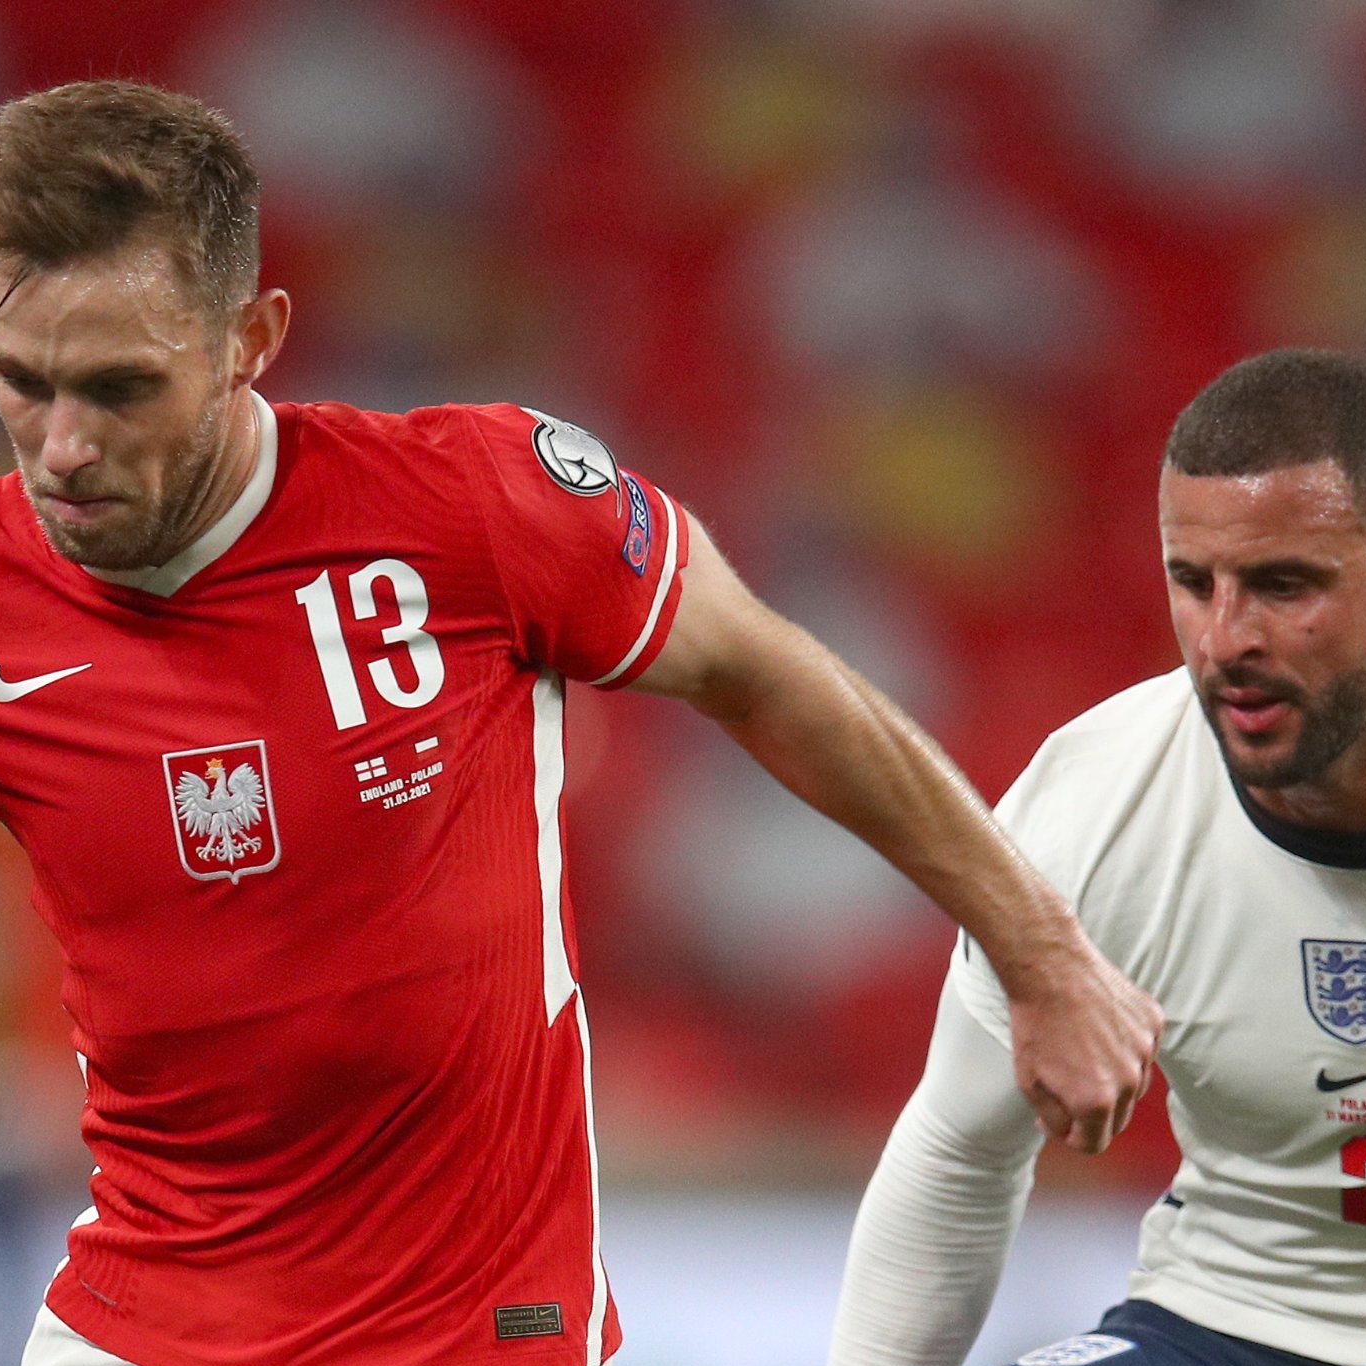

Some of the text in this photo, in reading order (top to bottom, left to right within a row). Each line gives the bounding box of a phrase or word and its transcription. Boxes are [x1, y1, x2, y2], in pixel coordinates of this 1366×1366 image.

[294, 558, 446, 731] 13
[359, 778, 404, 803] ENGLAND
[410, 761, 443, 784] POLAND
[382, 782, 432, 810] 31.03.2021
